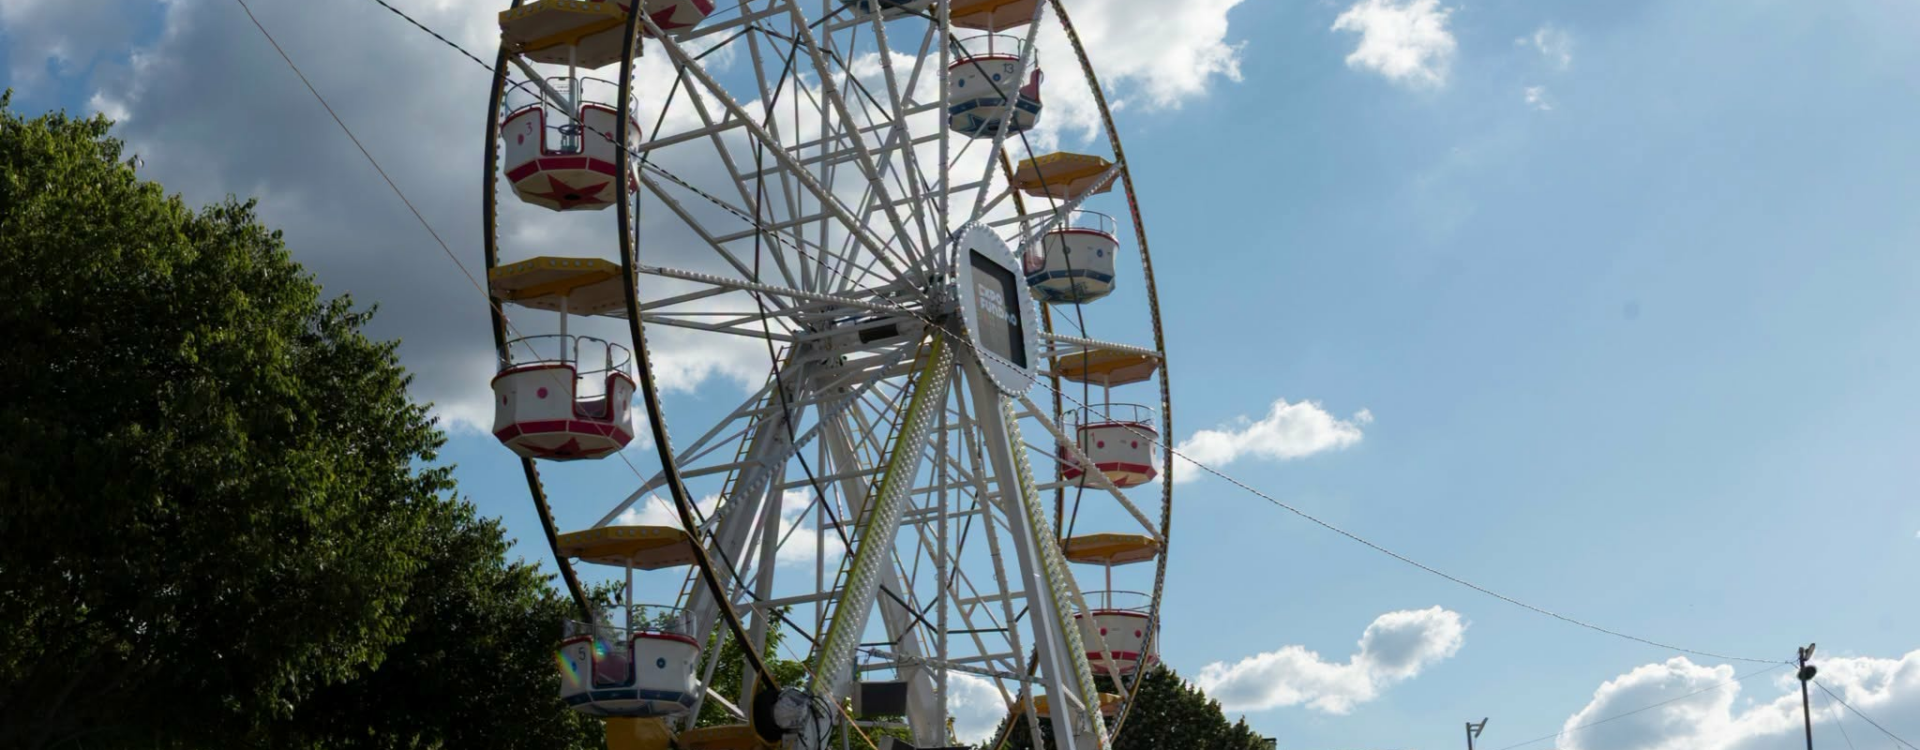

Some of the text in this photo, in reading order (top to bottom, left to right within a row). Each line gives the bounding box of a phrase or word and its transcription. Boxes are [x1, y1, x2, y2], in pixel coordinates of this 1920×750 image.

[1002, 63, 1014, 74] 13
[525, 121, 533, 136] 3
[978, 283, 1003, 306] EXPO
[578, 646, 586, 661] 5
